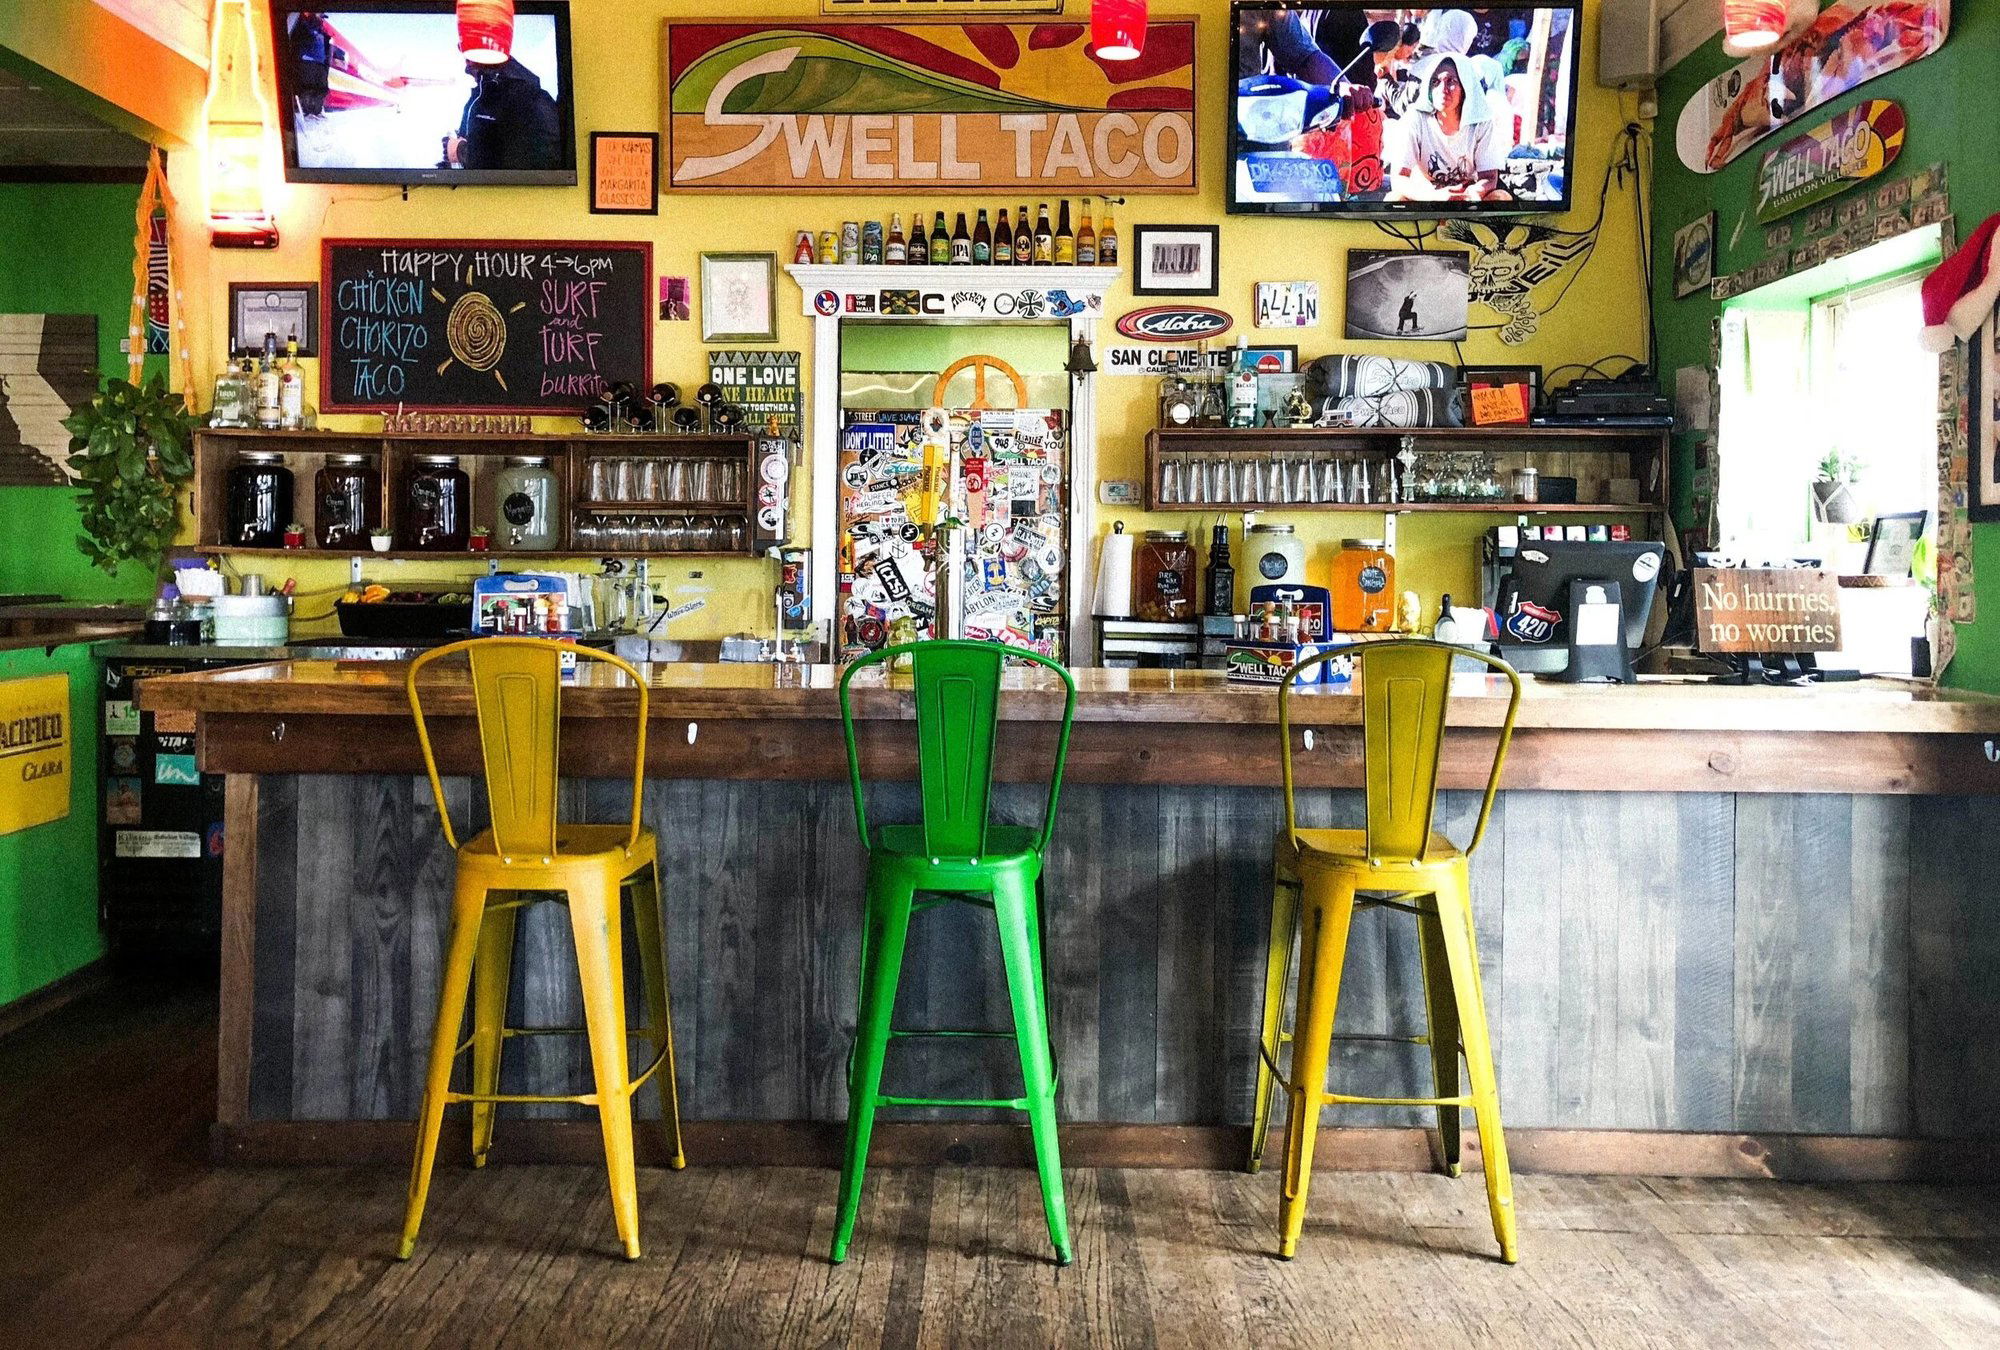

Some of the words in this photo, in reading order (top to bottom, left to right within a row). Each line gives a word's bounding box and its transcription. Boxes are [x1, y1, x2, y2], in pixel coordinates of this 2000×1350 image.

[673, 46, 981, 182] SWELL
[1000, 111, 1193, 179] TACO
[1820, 120, 1871, 174] TACO
[952, 244, 969, 258] IPA
[475, 250, 536, 280] HOUR
[540, 279, 607, 318] SURF
[547, 314, 584, 331] and
[1130, 313, 1222, 334] Aloha
[340, 316, 428, 362] CHORIZO
[538, 325, 603, 371] TURF
[1111, 349, 1141, 366] SAN
[350, 358, 405, 400] TACO
[712, 367, 747, 385] ONE
[752, 367, 796, 385] LOVE
[745, 386, 796, 402] HEART
[750, 403, 788, 412] TOGETHER
[854, 412, 877, 421] STREET
[845, 432, 867, 449] DON'T
[868, 432, 894, 450] LITTER
[1044, 441, 1065, 450] YOU
[1027, 458, 1047, 467] TACO
[871, 481, 889, 492] STANCE
[857, 500, 883, 508] HEALING
[1702, 583, 1738, 611] No
[1743, 584, 1838, 613] hurries,
[1517, 615, 1549, 638] 420
[1709, 622, 1741, 643] no
[1748, 616, 1836, 644] worries
[1227, 653, 1266, 676] SWELL
[22, 759, 63, 782] CLARA
